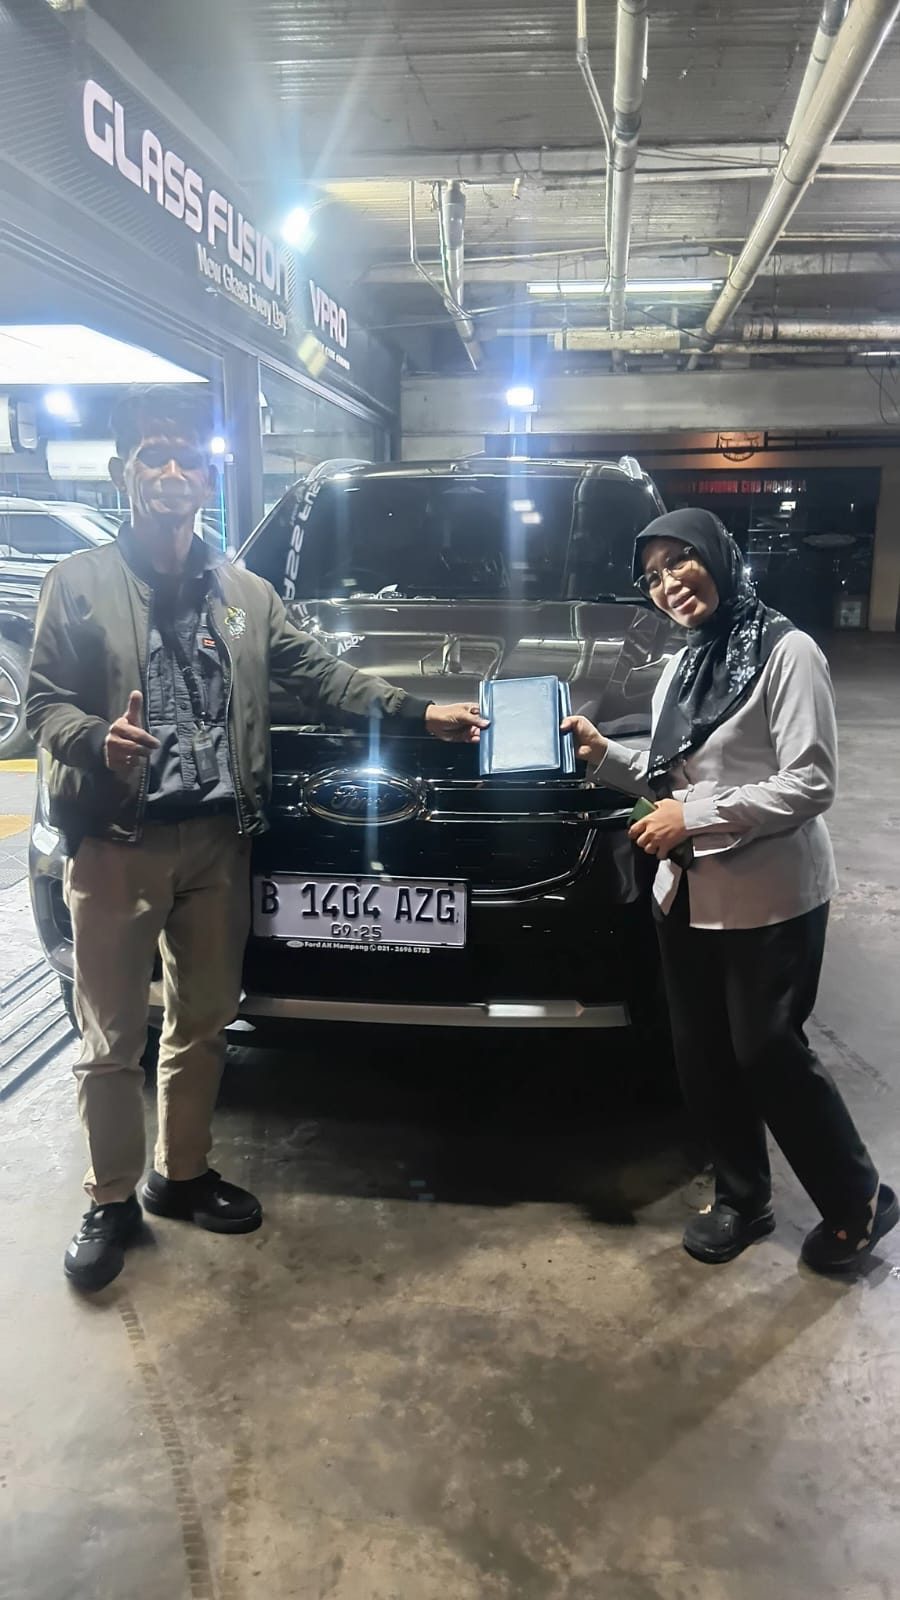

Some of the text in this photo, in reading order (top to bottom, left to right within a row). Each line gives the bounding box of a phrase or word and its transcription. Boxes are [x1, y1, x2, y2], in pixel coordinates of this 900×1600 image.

[83, 79, 290, 300] GLASS FUSION
[222, 263, 248, 303] Glass
[308, 279, 348, 349] VPRO
[260, 880, 456, 924] B 1404 AZG
[303, 941, 321, 949] Ford
